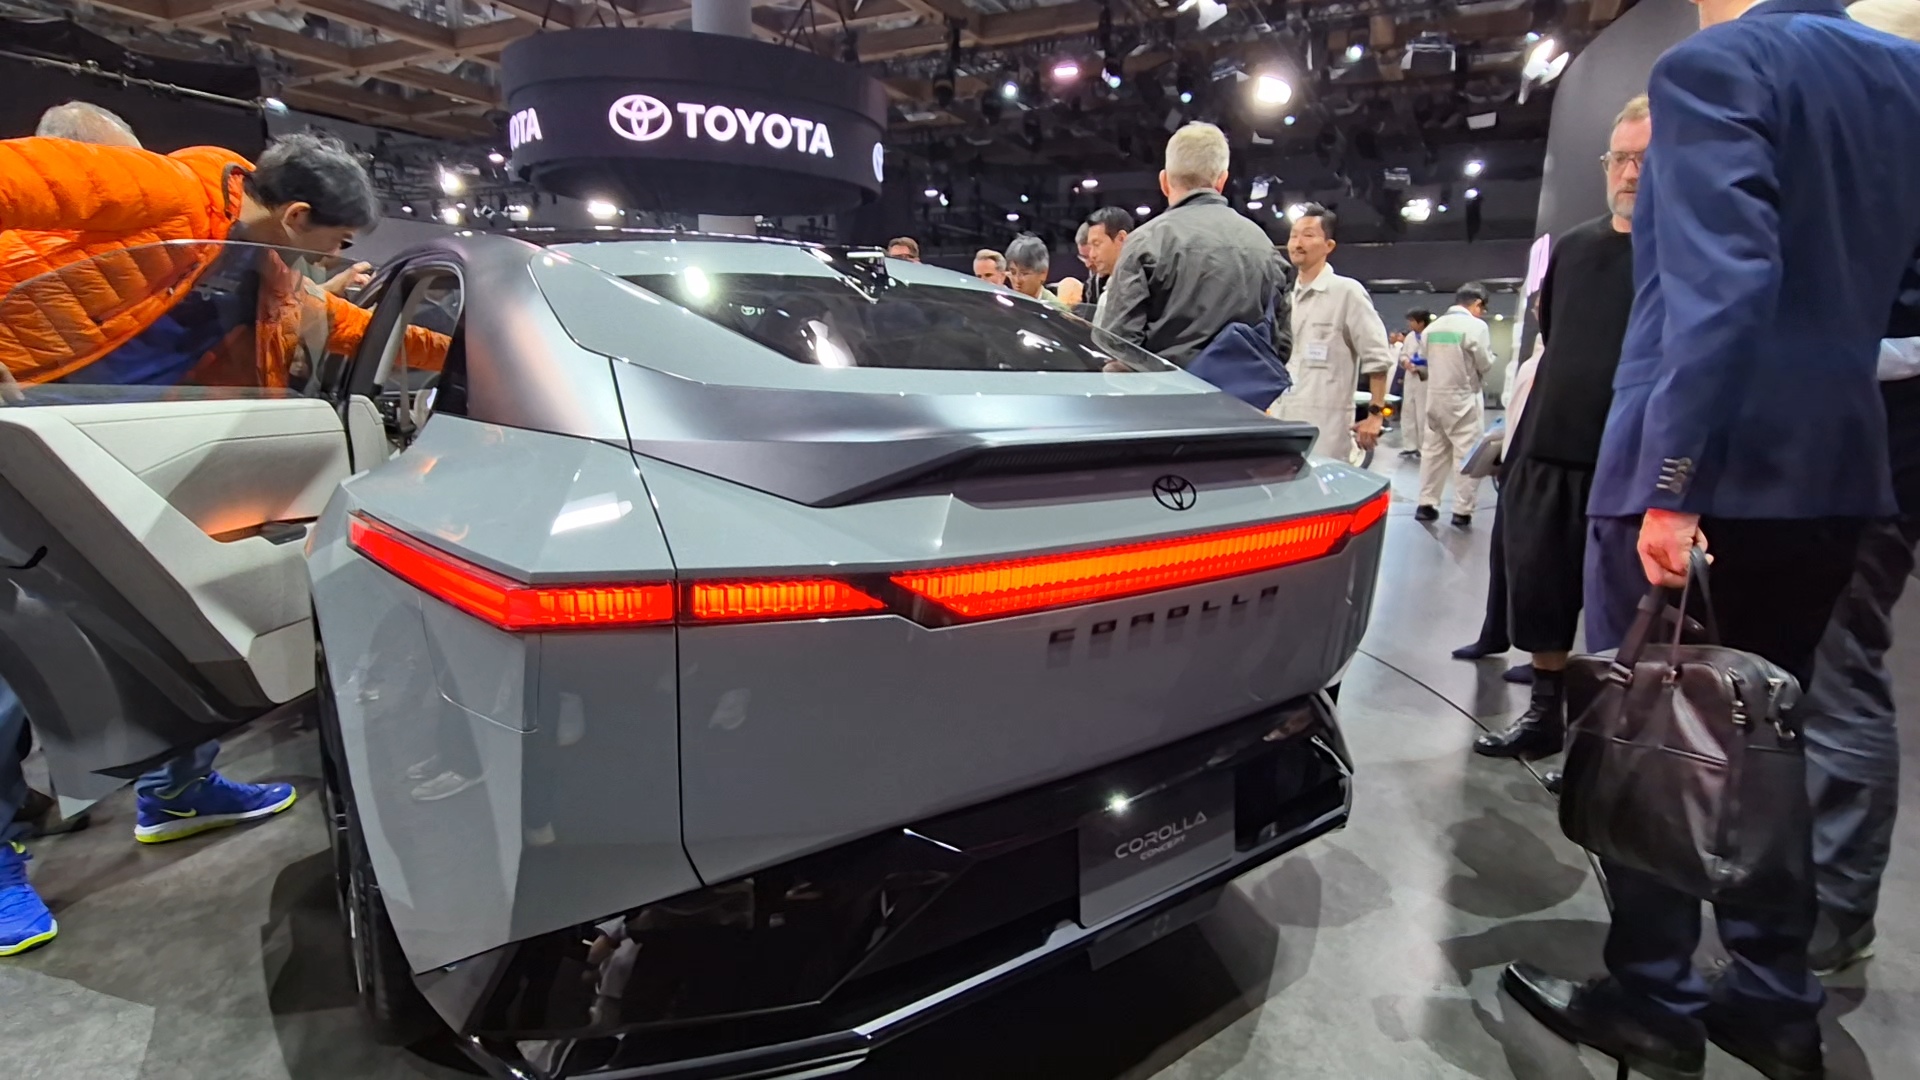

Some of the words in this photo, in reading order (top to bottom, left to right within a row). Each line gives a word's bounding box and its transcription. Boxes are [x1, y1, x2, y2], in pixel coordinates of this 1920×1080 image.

[677, 102, 834, 158] TOYOTA
[1049, 585, 1279, 644] COROLLA
[1115, 811, 1207, 859] COROLLA
[1140, 834, 1186, 860] CONCEPT
